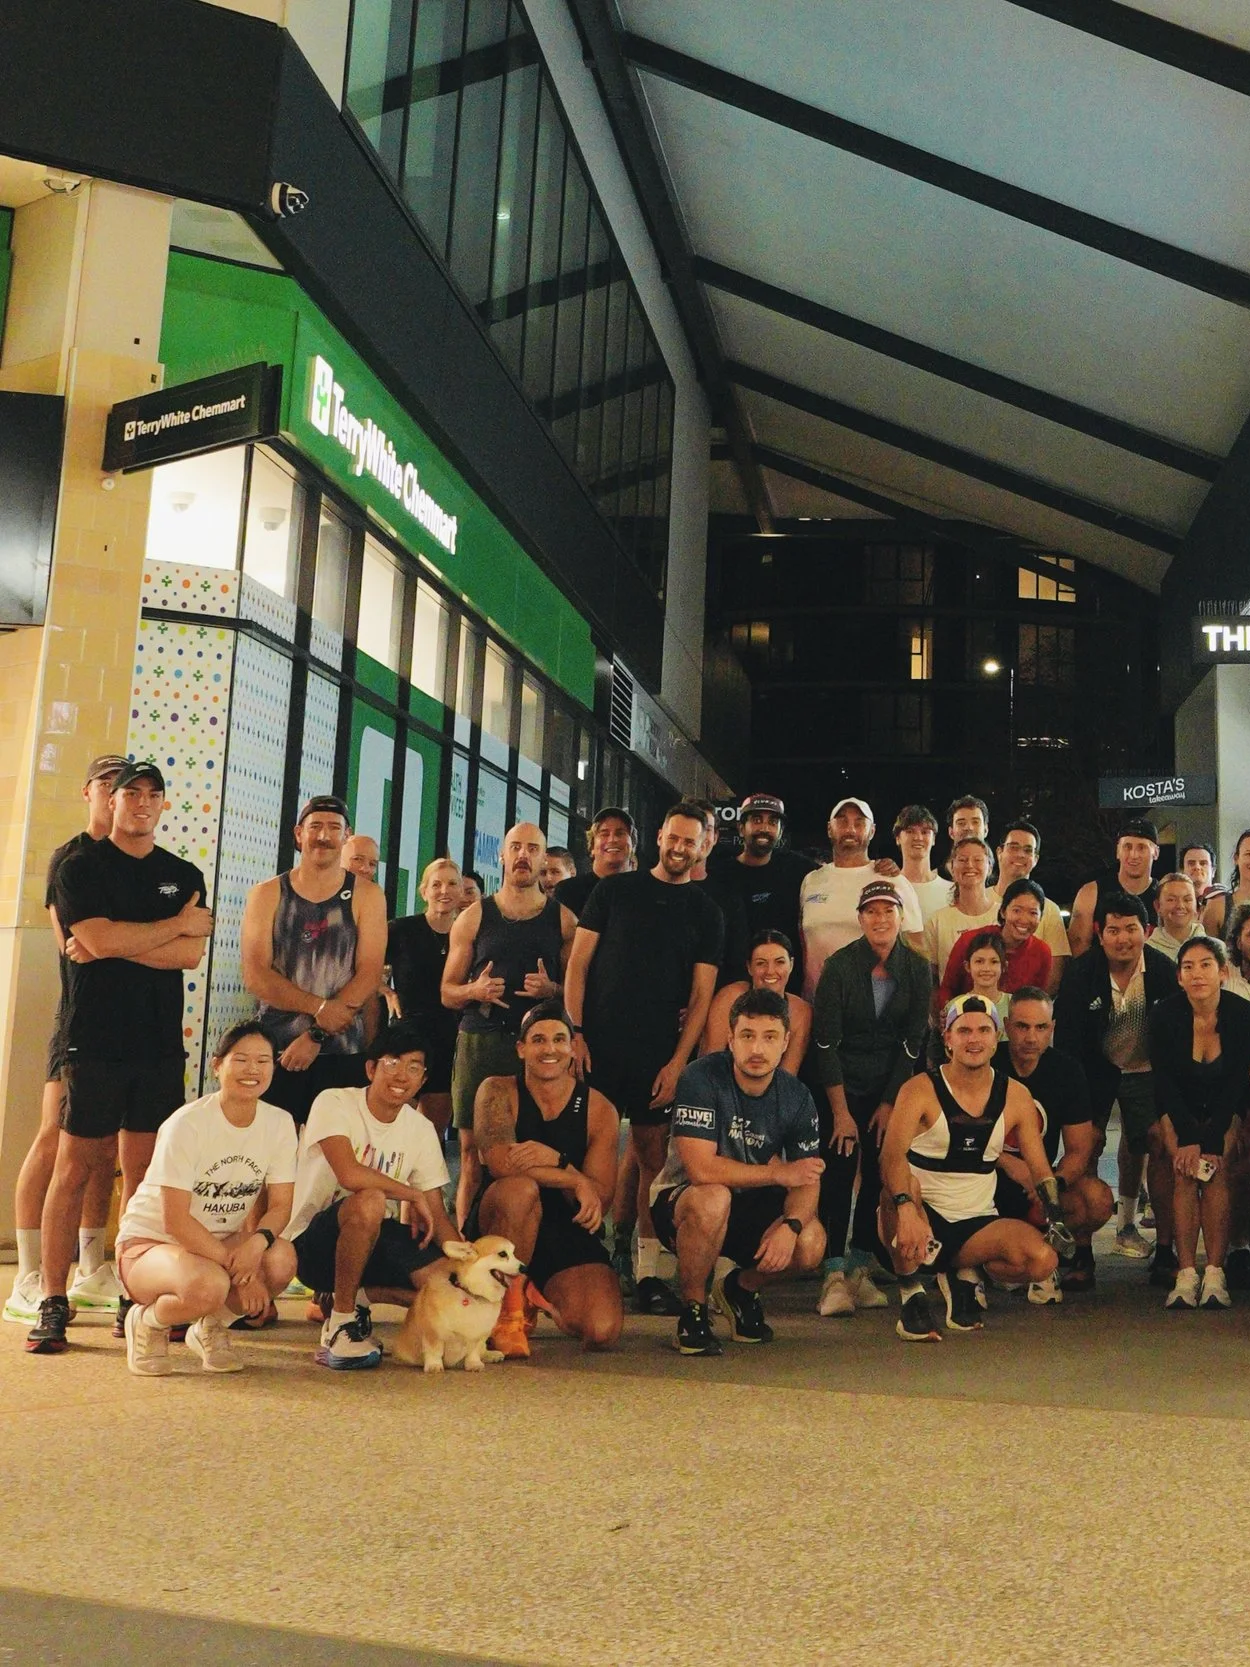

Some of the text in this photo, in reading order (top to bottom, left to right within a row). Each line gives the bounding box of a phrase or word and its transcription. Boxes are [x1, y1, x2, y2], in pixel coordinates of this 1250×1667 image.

[136, 394, 246, 436] TerryWhite Chemmart
[333, 381, 458, 555] TerryWhite Chemmart
[1123, 778, 1185, 801] KOSTA'S
[1149, 791, 1186, 803] takeaway
[688, 1109, 713, 1122] LIVE!
[205, 1162, 221, 1177] THE
[244, 1158, 262, 1176] FACE
[203, 1203, 246, 1213] HAKUBA
